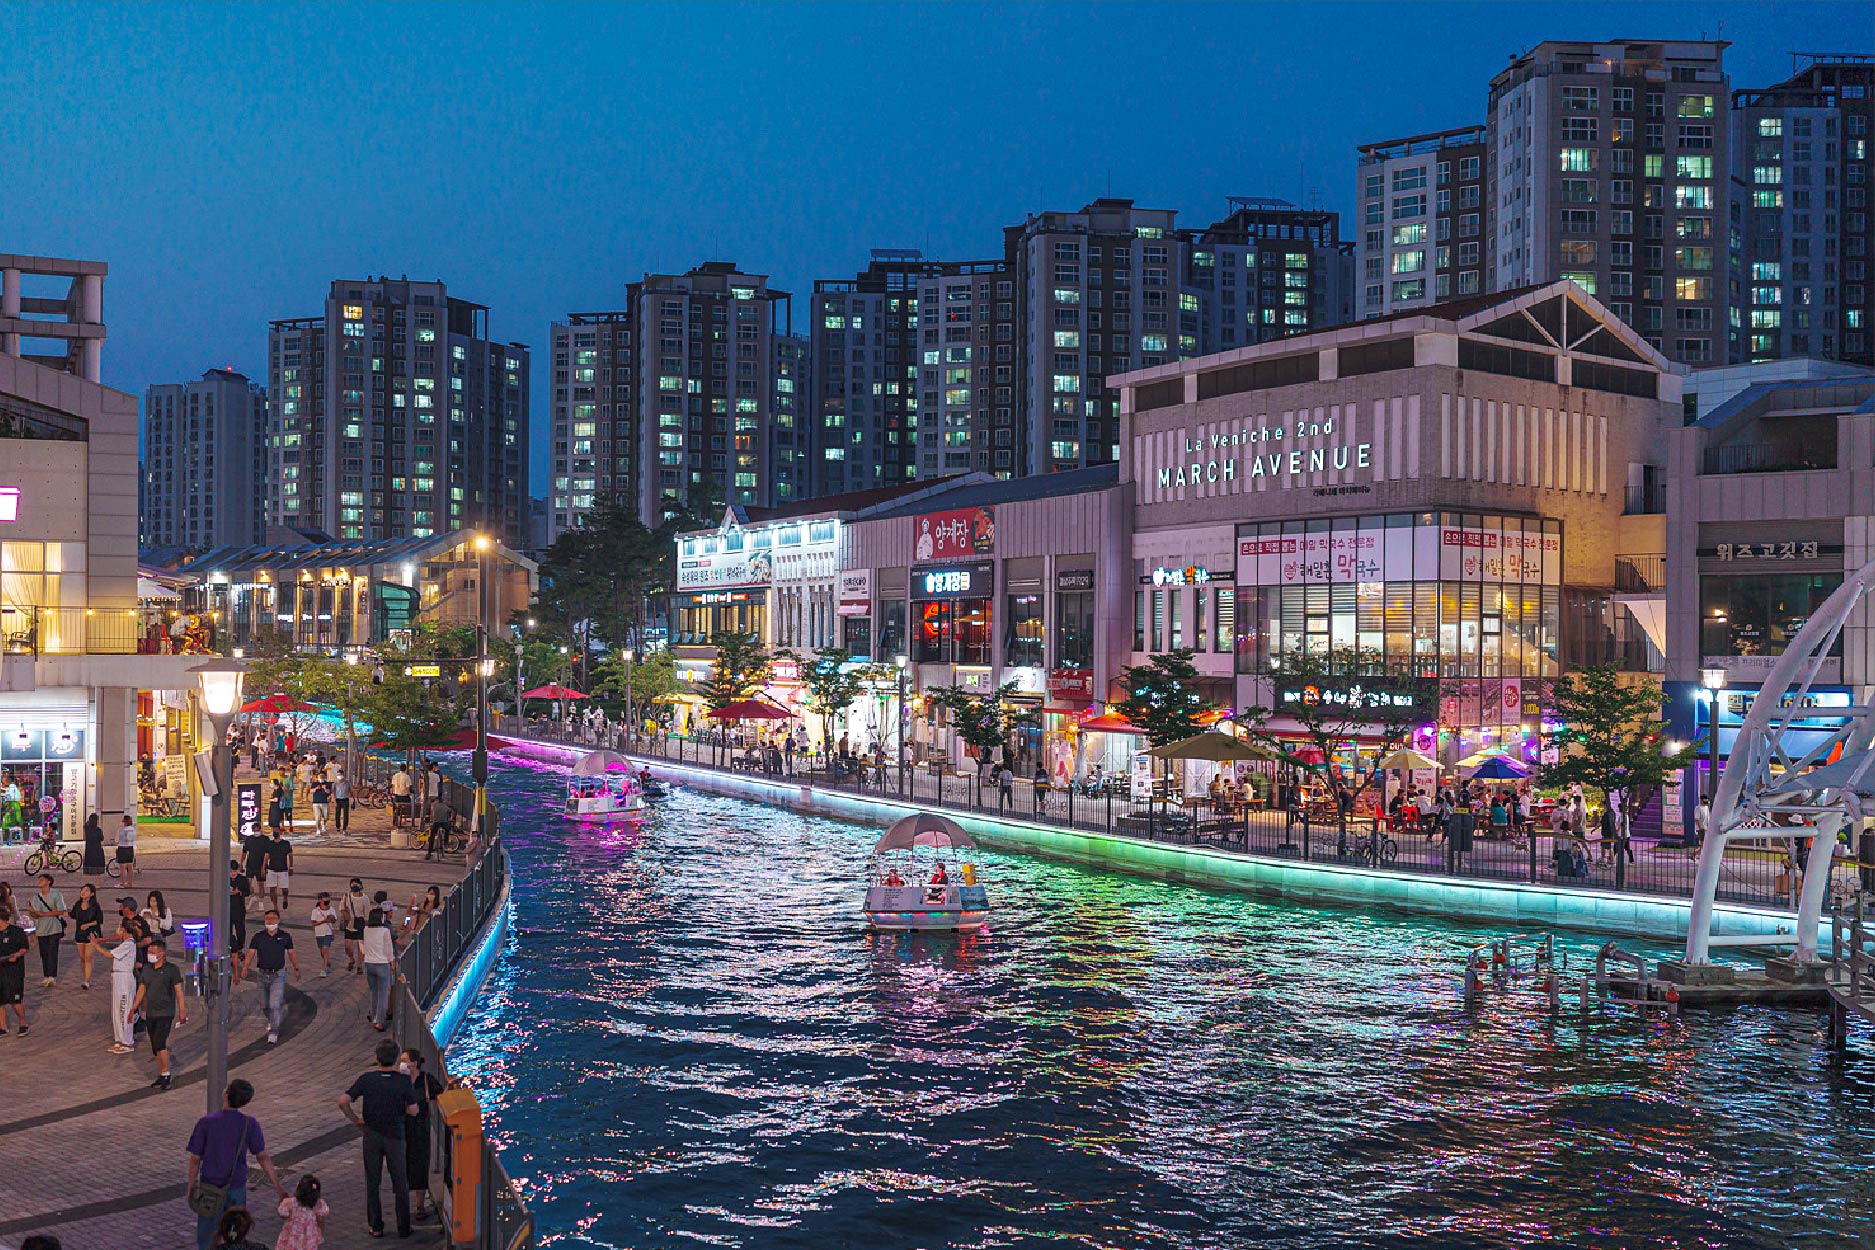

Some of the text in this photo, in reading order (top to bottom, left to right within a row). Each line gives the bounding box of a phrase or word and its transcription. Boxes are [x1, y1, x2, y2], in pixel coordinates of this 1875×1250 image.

[1186, 418, 1333, 453] La Veniche 2nd
[1158, 444, 1372, 489] MARCH AVENUE
[1717, 541, 1818, 561] 위즈고깃집
